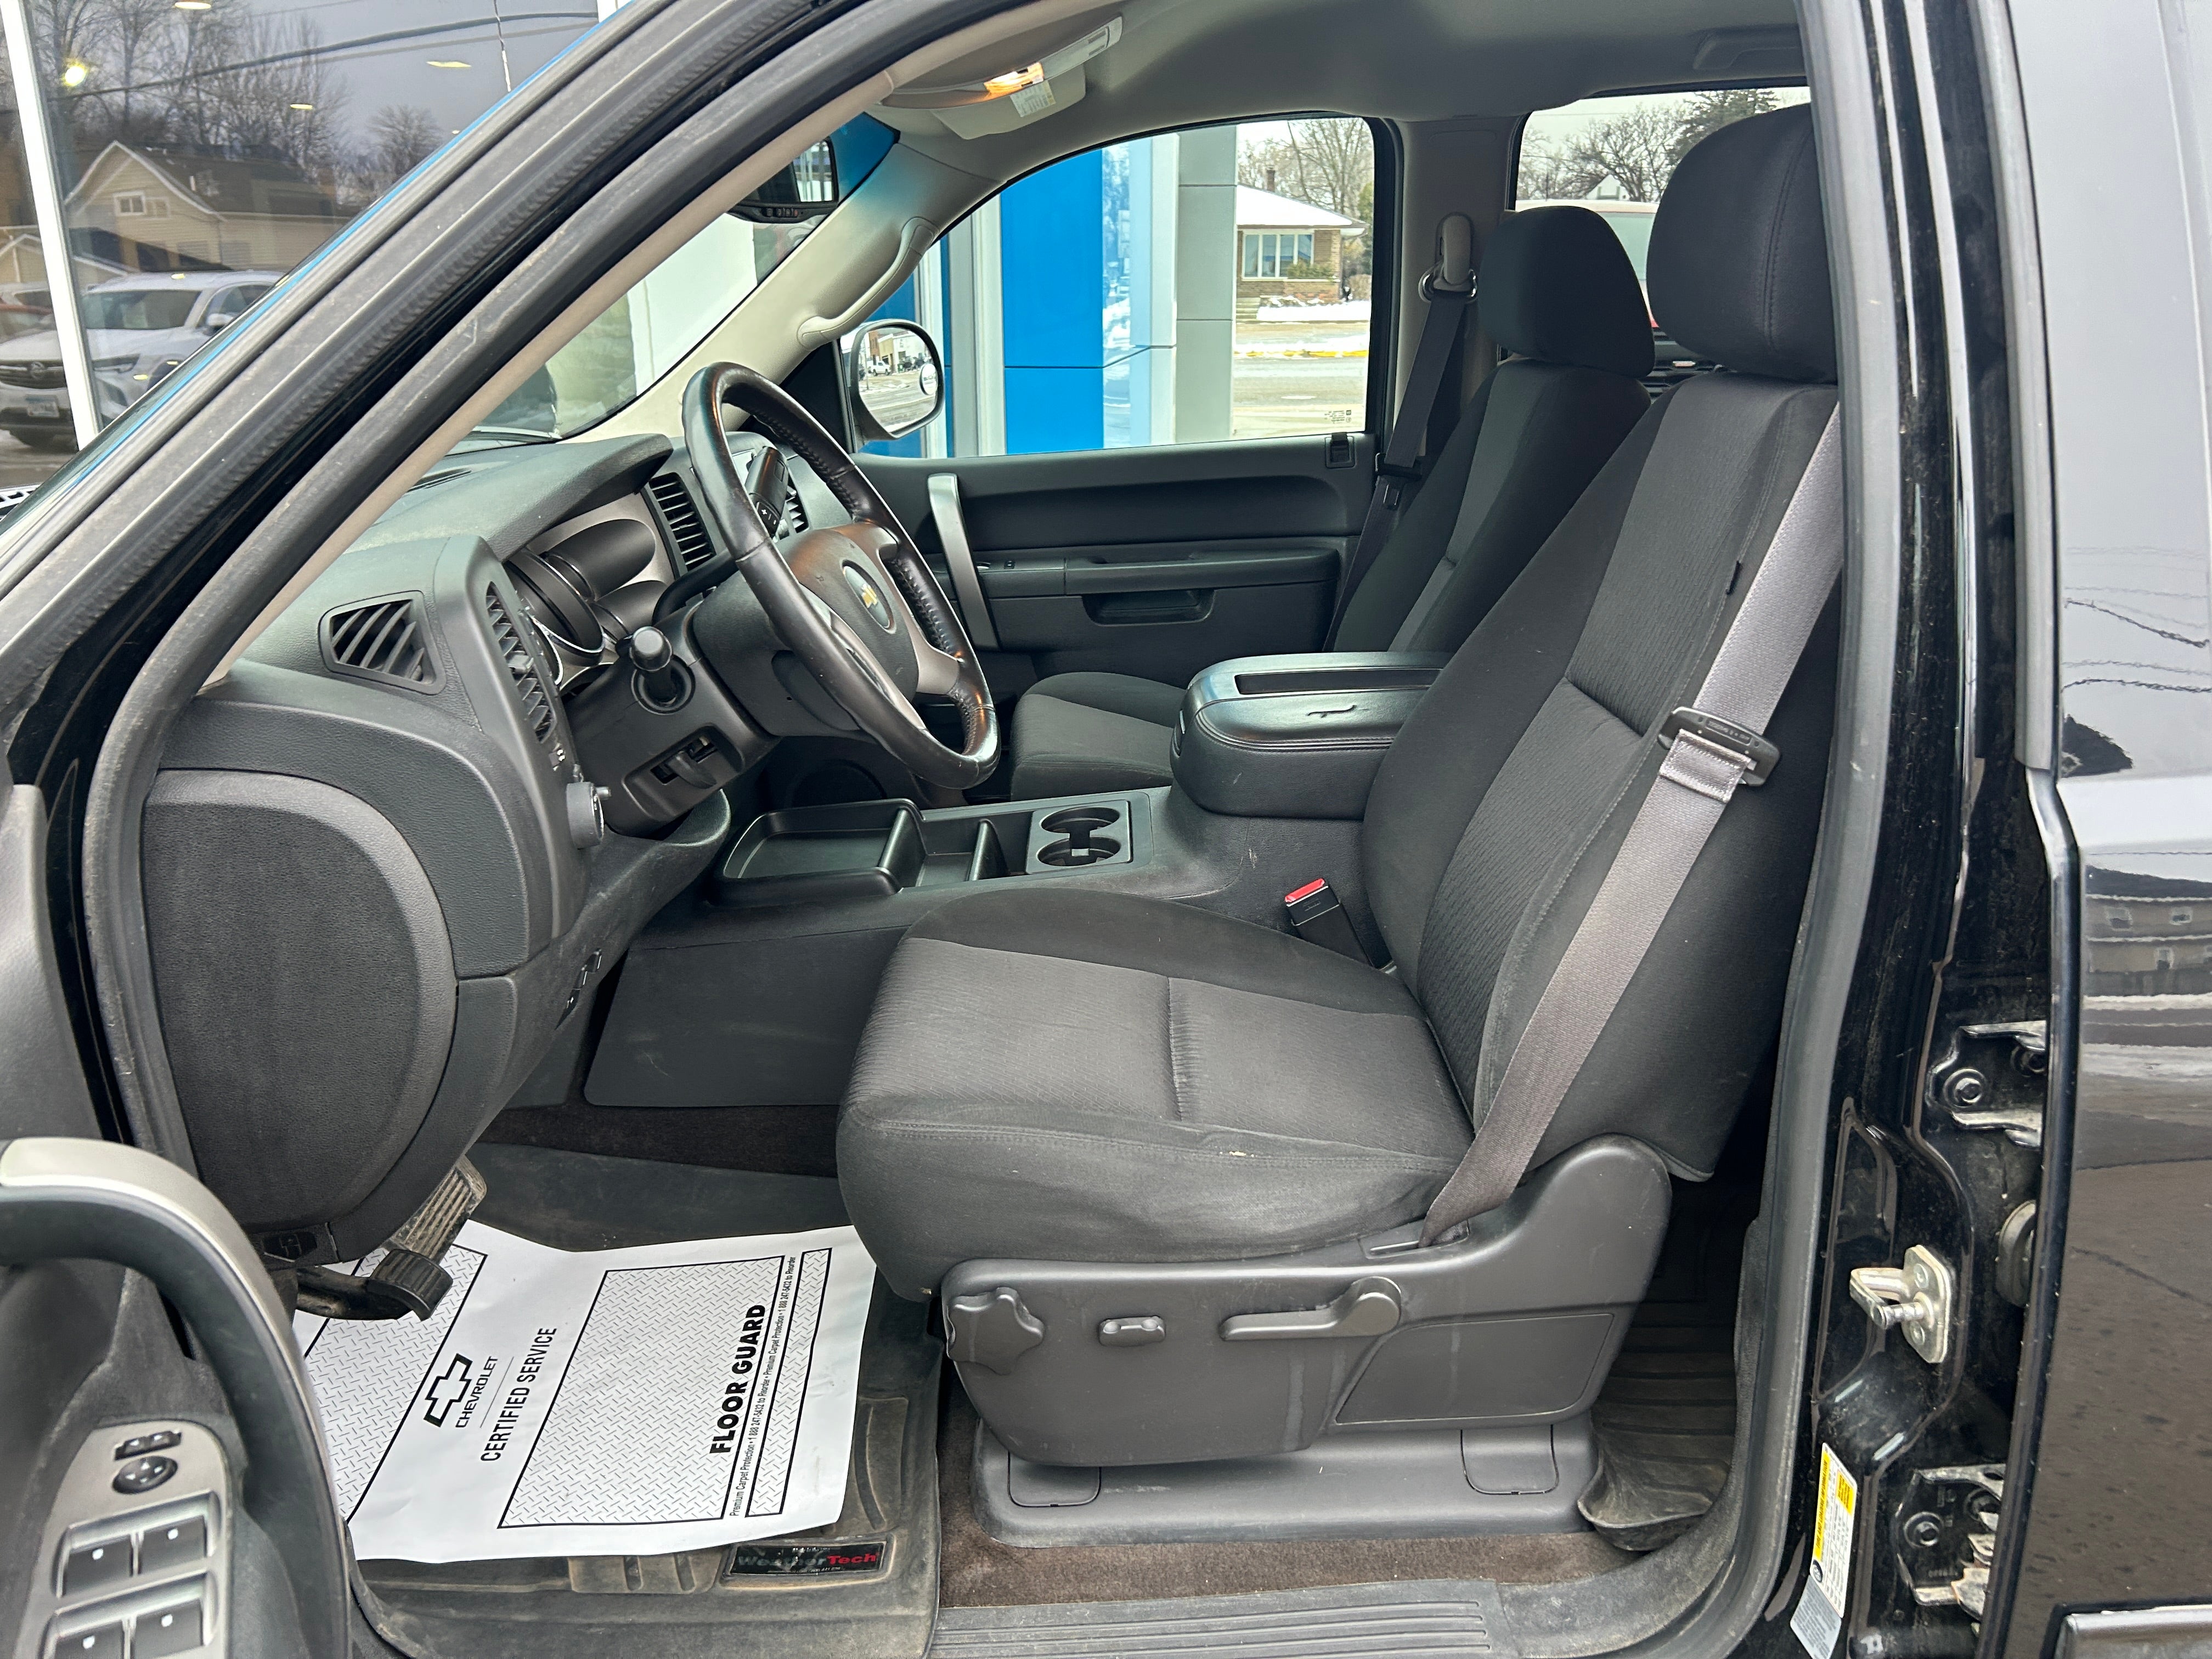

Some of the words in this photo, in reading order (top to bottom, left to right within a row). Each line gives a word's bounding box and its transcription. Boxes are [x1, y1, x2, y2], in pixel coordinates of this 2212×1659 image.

[455, 1356, 498, 1428] CHEVROLET
[480, 1387, 530, 1461] CERTIFIED
[517, 1328, 557, 1383] SERVICE
[709, 1381, 748, 1454] FLOOR
[732, 1305, 765, 1374] GUARD
[736, 1472, 749, 1491] Carpet
[740, 1443, 755, 1474] Protection
[730, 1491, 744, 1516] Premium
